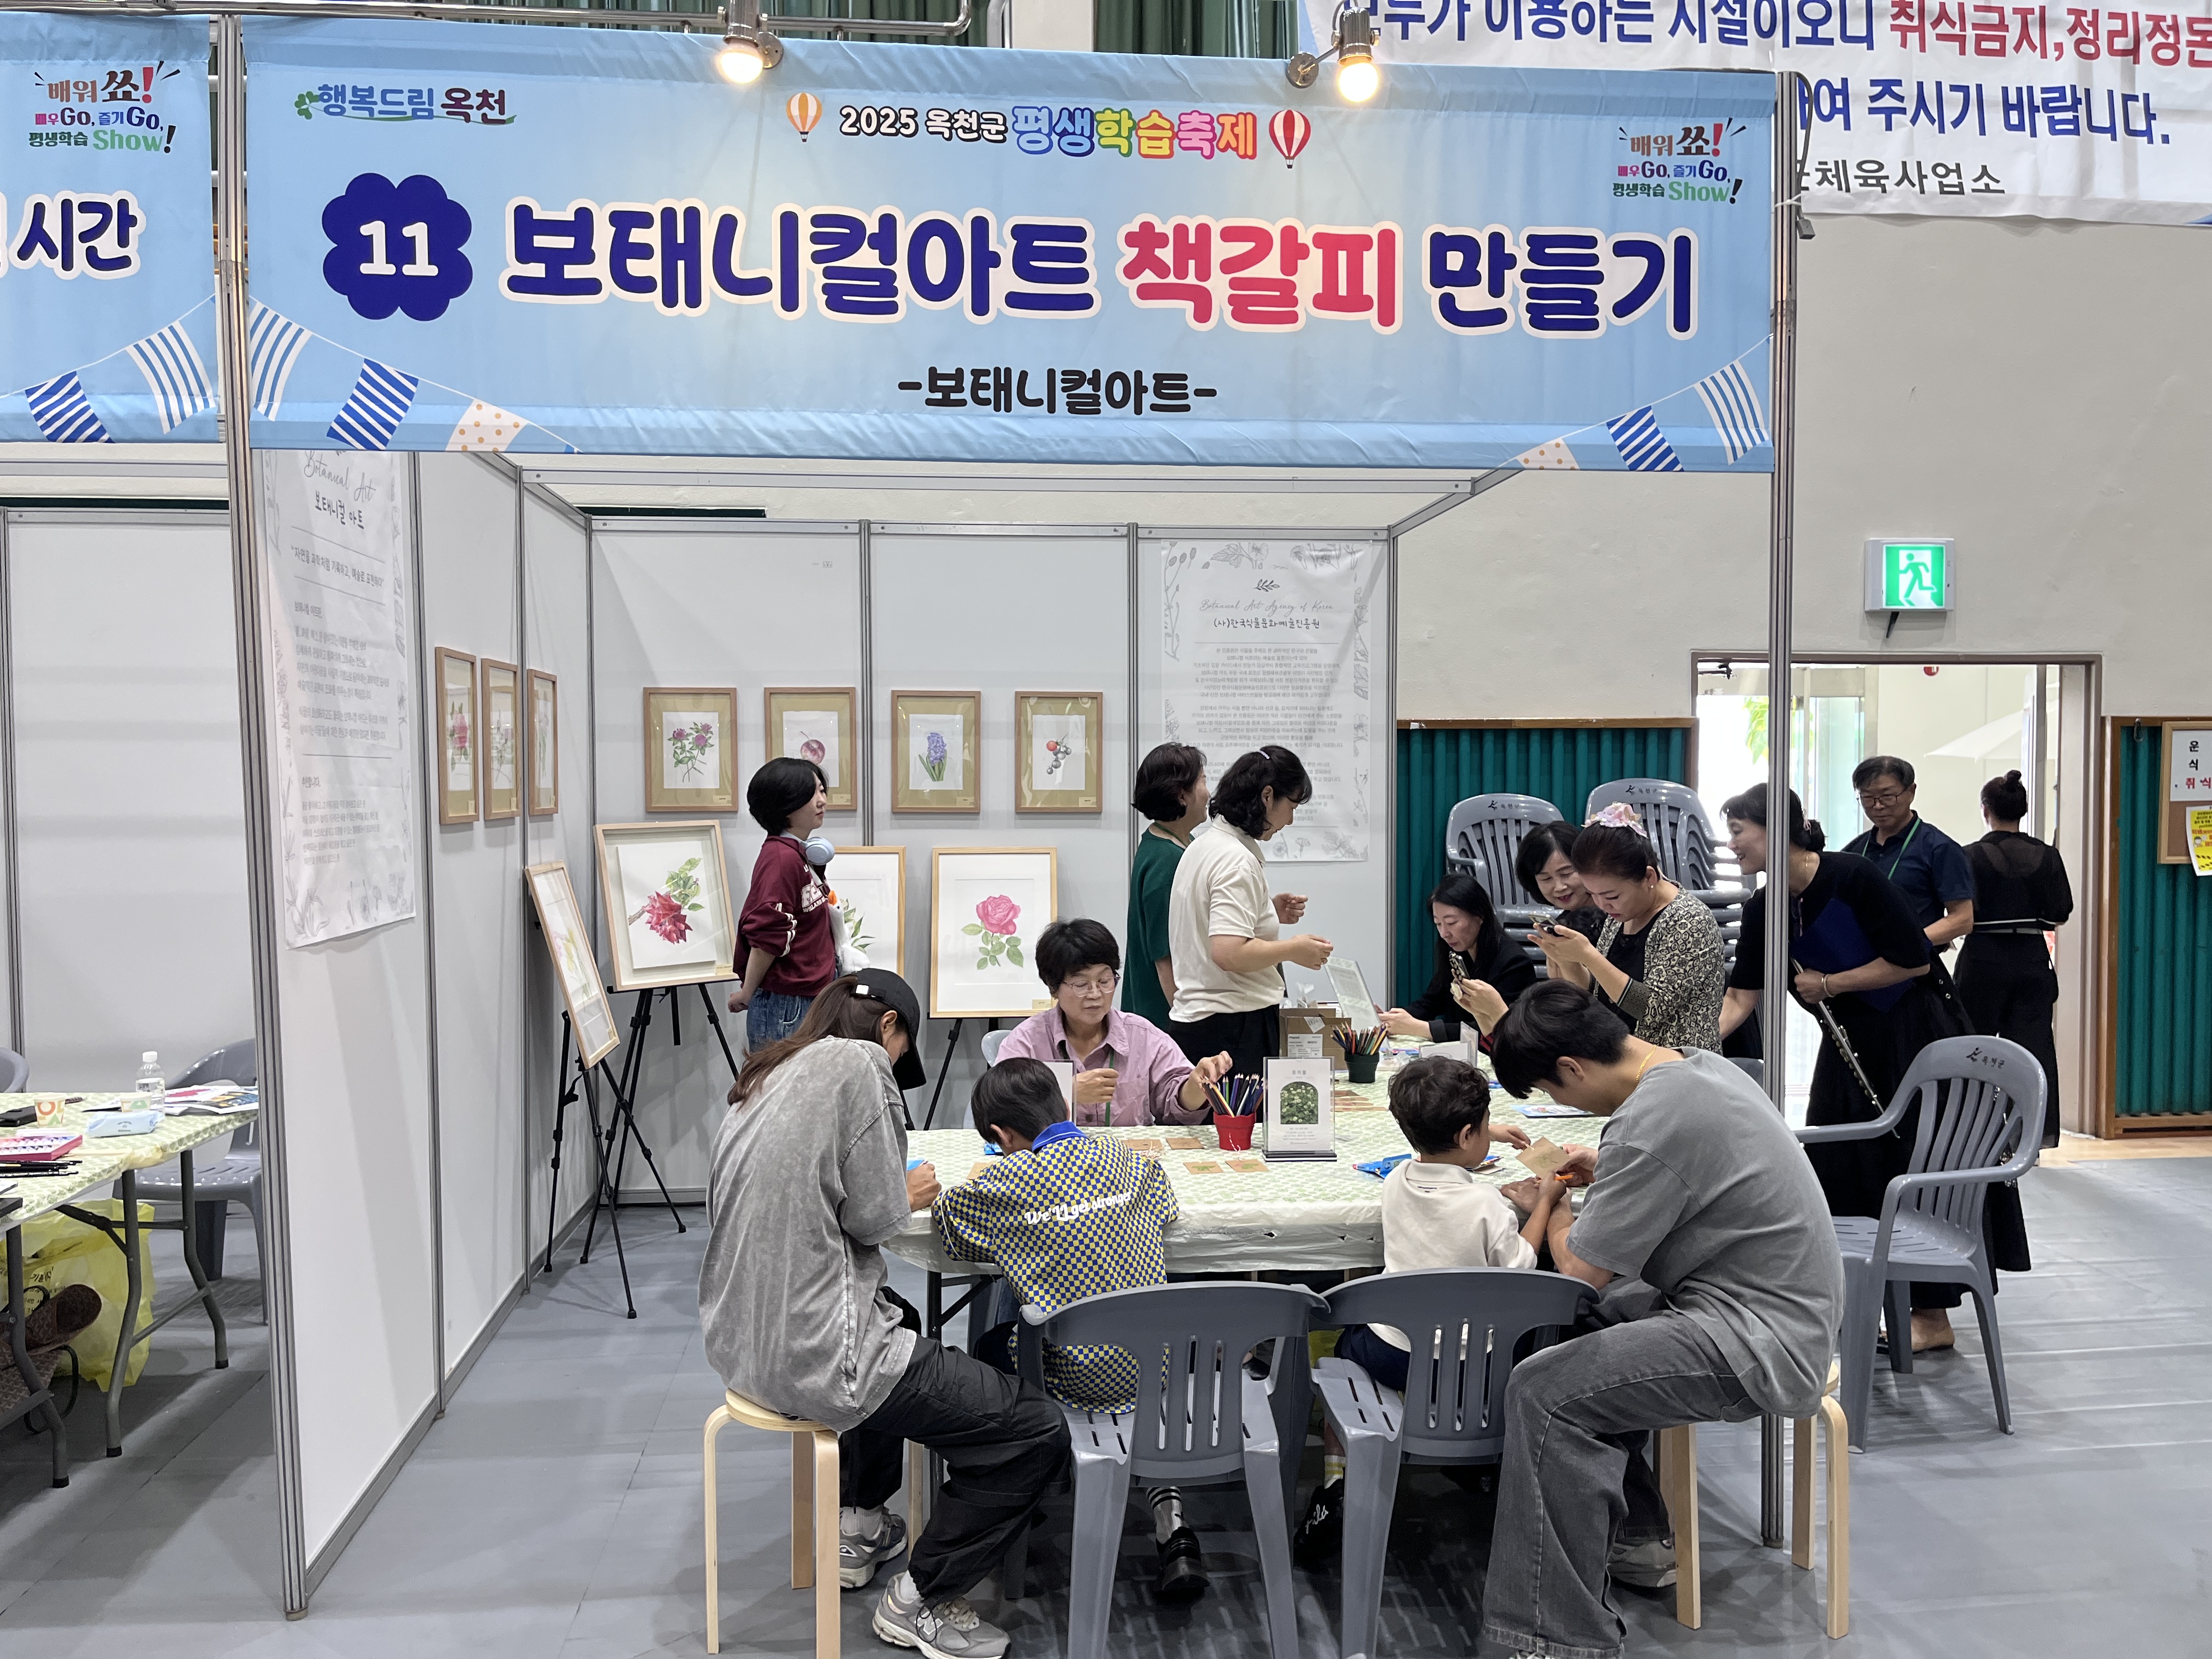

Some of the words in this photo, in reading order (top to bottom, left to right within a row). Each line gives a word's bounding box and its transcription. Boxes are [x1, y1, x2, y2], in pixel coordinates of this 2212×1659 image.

[1668, 0, 1875, 51] 시설이오니
[47, 79, 98, 103] 배워
[318, 83, 435, 121] 행복드림
[441, 87, 506, 125] 옥천
[35, 107, 95, 127] 배우Go,
[98, 106, 163, 132] 즐기Go,
[1867, 79, 1987, 136] 주시기
[2001, 84, 2170, 145] 바랍니다.
[29, 131, 89, 147] 평생학습
[93, 125, 177, 154] Show!
[840, 105, 918, 137] 2025
[925, 108, 1008, 143] 옥천군
[1012, 105, 1257, 160] 평생학습축제
[1630, 134, 1673, 157] 배워
[1617, 161, 1671, 178] 배우Go,
[1673, 159, 1731, 183] 즐기Go,
[1612, 182, 1666, 198] 평생학습
[1668, 178, 1743, 205] Show!
[17, 198, 138, 272] 시간
[359, 220, 439, 277] 11
[506, 204, 1095, 317] 보태니컬아트
[1122, 221, 1396, 328] 책갈피
[1429, 231, 1691, 333] 만들기
[354, 472, 377, 503] Art
[315, 489, 346, 526] 보태니컬
[349, 510, 364, 530] 아트
[1199, 599, 1241, 612] Botanical
[1244, 599, 1265, 612] Art
[1265, 599, 1298, 618] Agency
[1300, 602, 1310, 613] of
[1312, 600, 1334, 613] Korea
[1214, 617, 1320, 630] (사)한국식물문화예술진흥원
[1071, 1199, 1091, 1220] get
[1091, 1191, 1132, 1210] stronger
